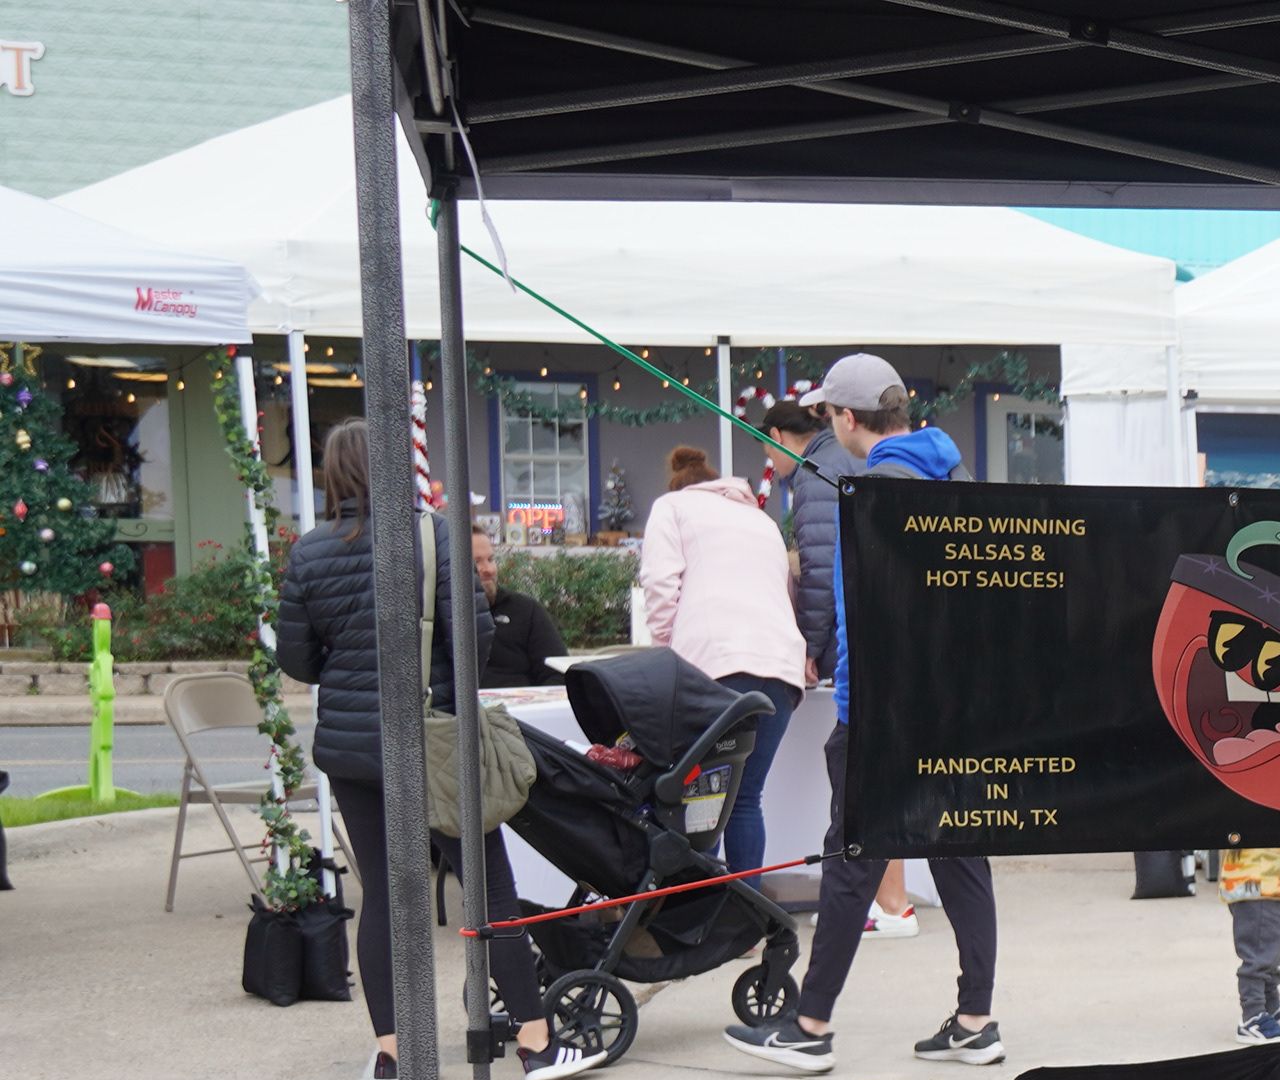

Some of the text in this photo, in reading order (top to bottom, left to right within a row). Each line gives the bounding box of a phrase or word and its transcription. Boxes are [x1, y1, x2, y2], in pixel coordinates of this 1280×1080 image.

[135, 287, 183, 311] Master
[153, 300, 198, 318] Canopy
[904, 515, 1087, 536] AWARD WINNING
[945, 543, 1046, 562] SALSAS &
[926, 570, 1065, 588] HOT SAUCES!
[918, 757, 1076, 774] HANDCRAFTED
[986, 784, 1009, 800] IN
[938, 809, 1058, 830] AUSTIN, TX
